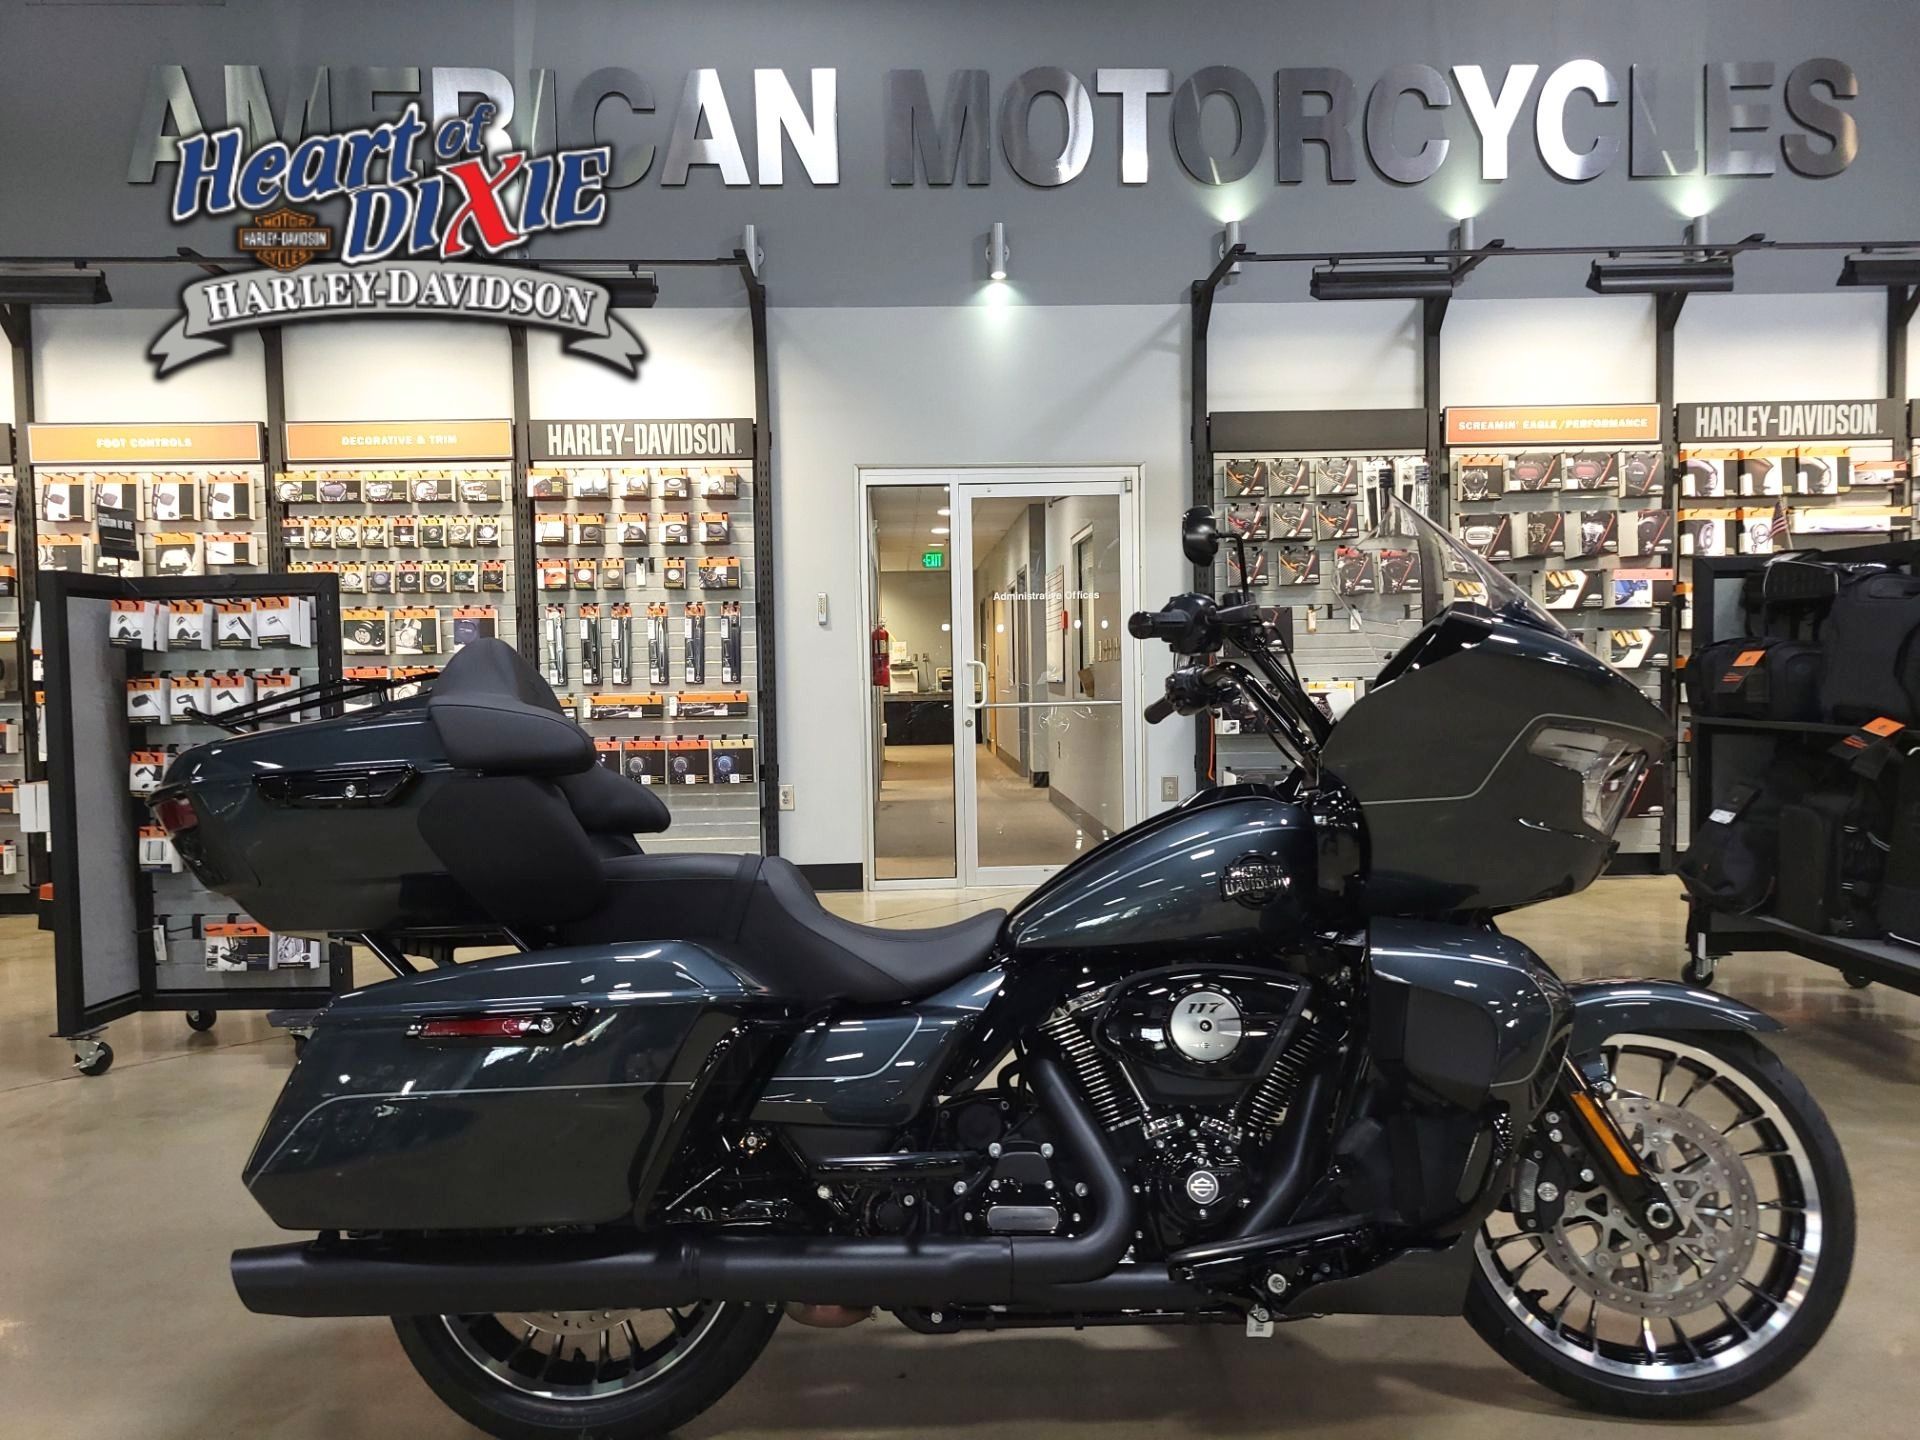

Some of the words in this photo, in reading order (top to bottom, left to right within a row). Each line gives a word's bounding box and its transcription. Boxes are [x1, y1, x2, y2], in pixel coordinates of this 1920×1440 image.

[888, 57, 1860, 188] MOTORCYCLES
[1458, 420, 1519, 431] SCREAMIN'
[1695, 403, 1878, 438] HARLEY-DAVIDSON
[96, 437, 126, 449] FOOT
[129, 437, 192, 449] CONTROLS
[341, 435, 413, 446] DECORATIVE
[428, 435, 457, 446] TRIM
[547, 422, 736, 456] HARLEY-DAVIDSON
[925, 553, 942, 567] EXIT
[1064, 590, 1100, 600] Offices
[1187, 1002, 1225, 1014] 117
